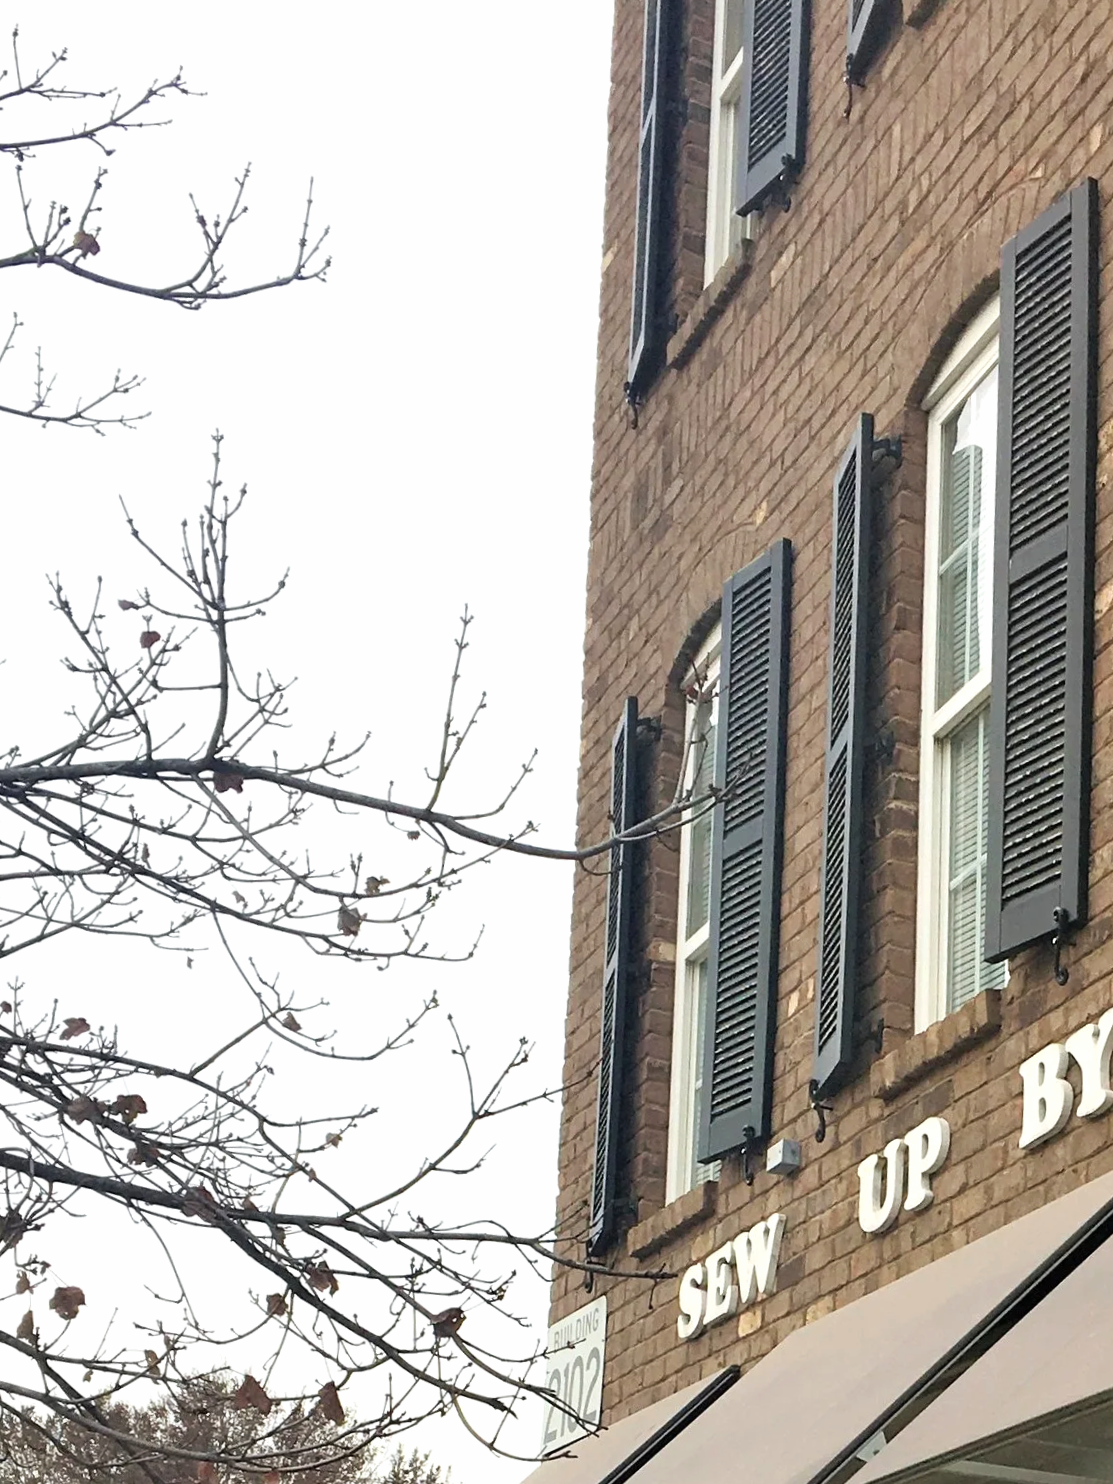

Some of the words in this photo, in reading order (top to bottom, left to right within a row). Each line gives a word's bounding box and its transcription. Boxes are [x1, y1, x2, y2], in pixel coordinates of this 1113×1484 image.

[677, 1212, 786, 1339] SEW
[858, 1117, 950, 1233] UP
[554, 1307, 600, 1353] BUILDING
[543, 1346, 601, 1445] 2102
